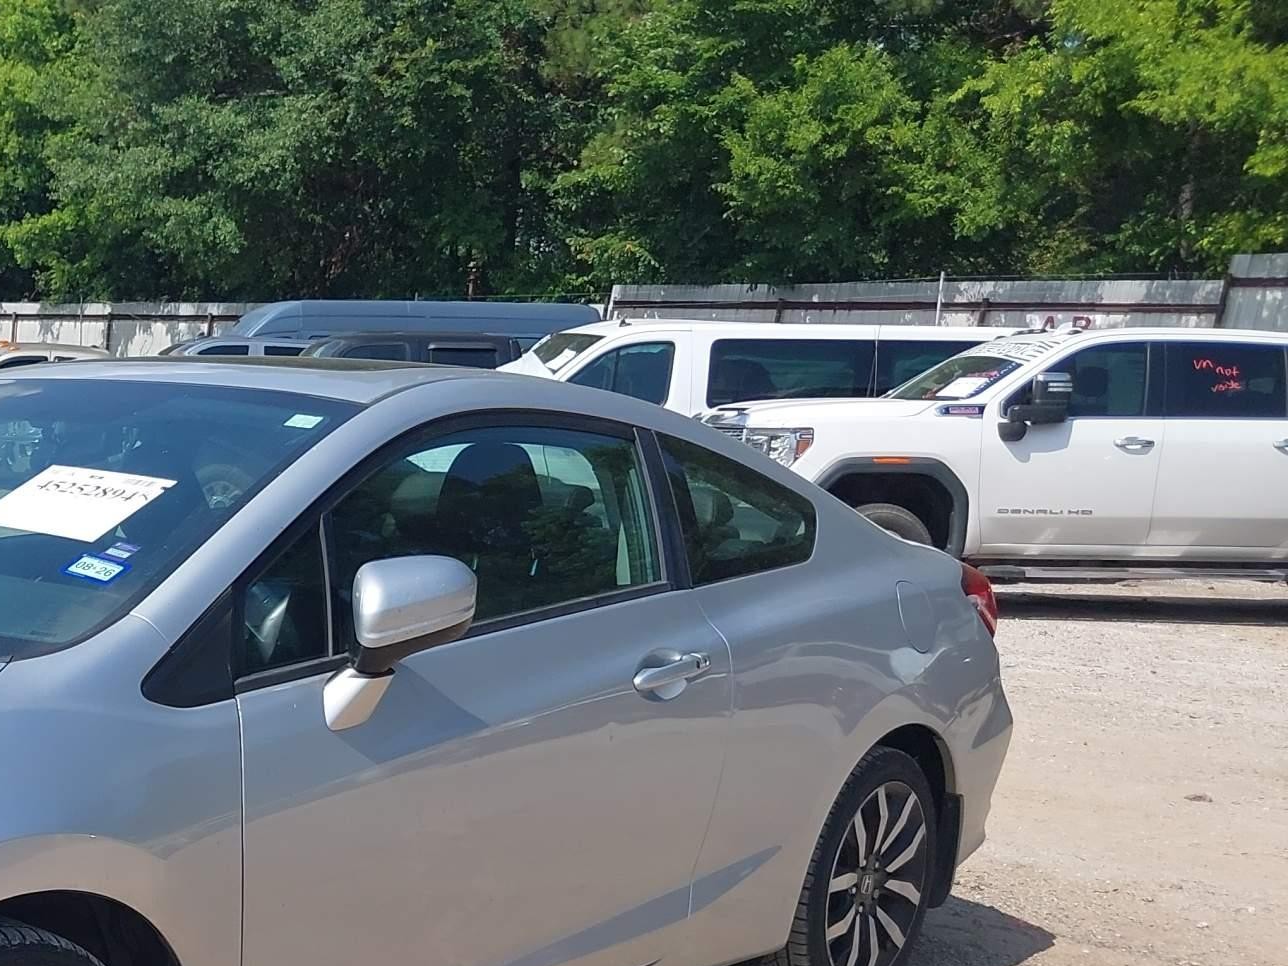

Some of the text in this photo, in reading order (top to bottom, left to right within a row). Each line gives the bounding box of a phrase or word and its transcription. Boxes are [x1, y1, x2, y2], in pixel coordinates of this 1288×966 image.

[37, 480, 138, 501] 45252894
[75, 561, 115, 577] 08 26
